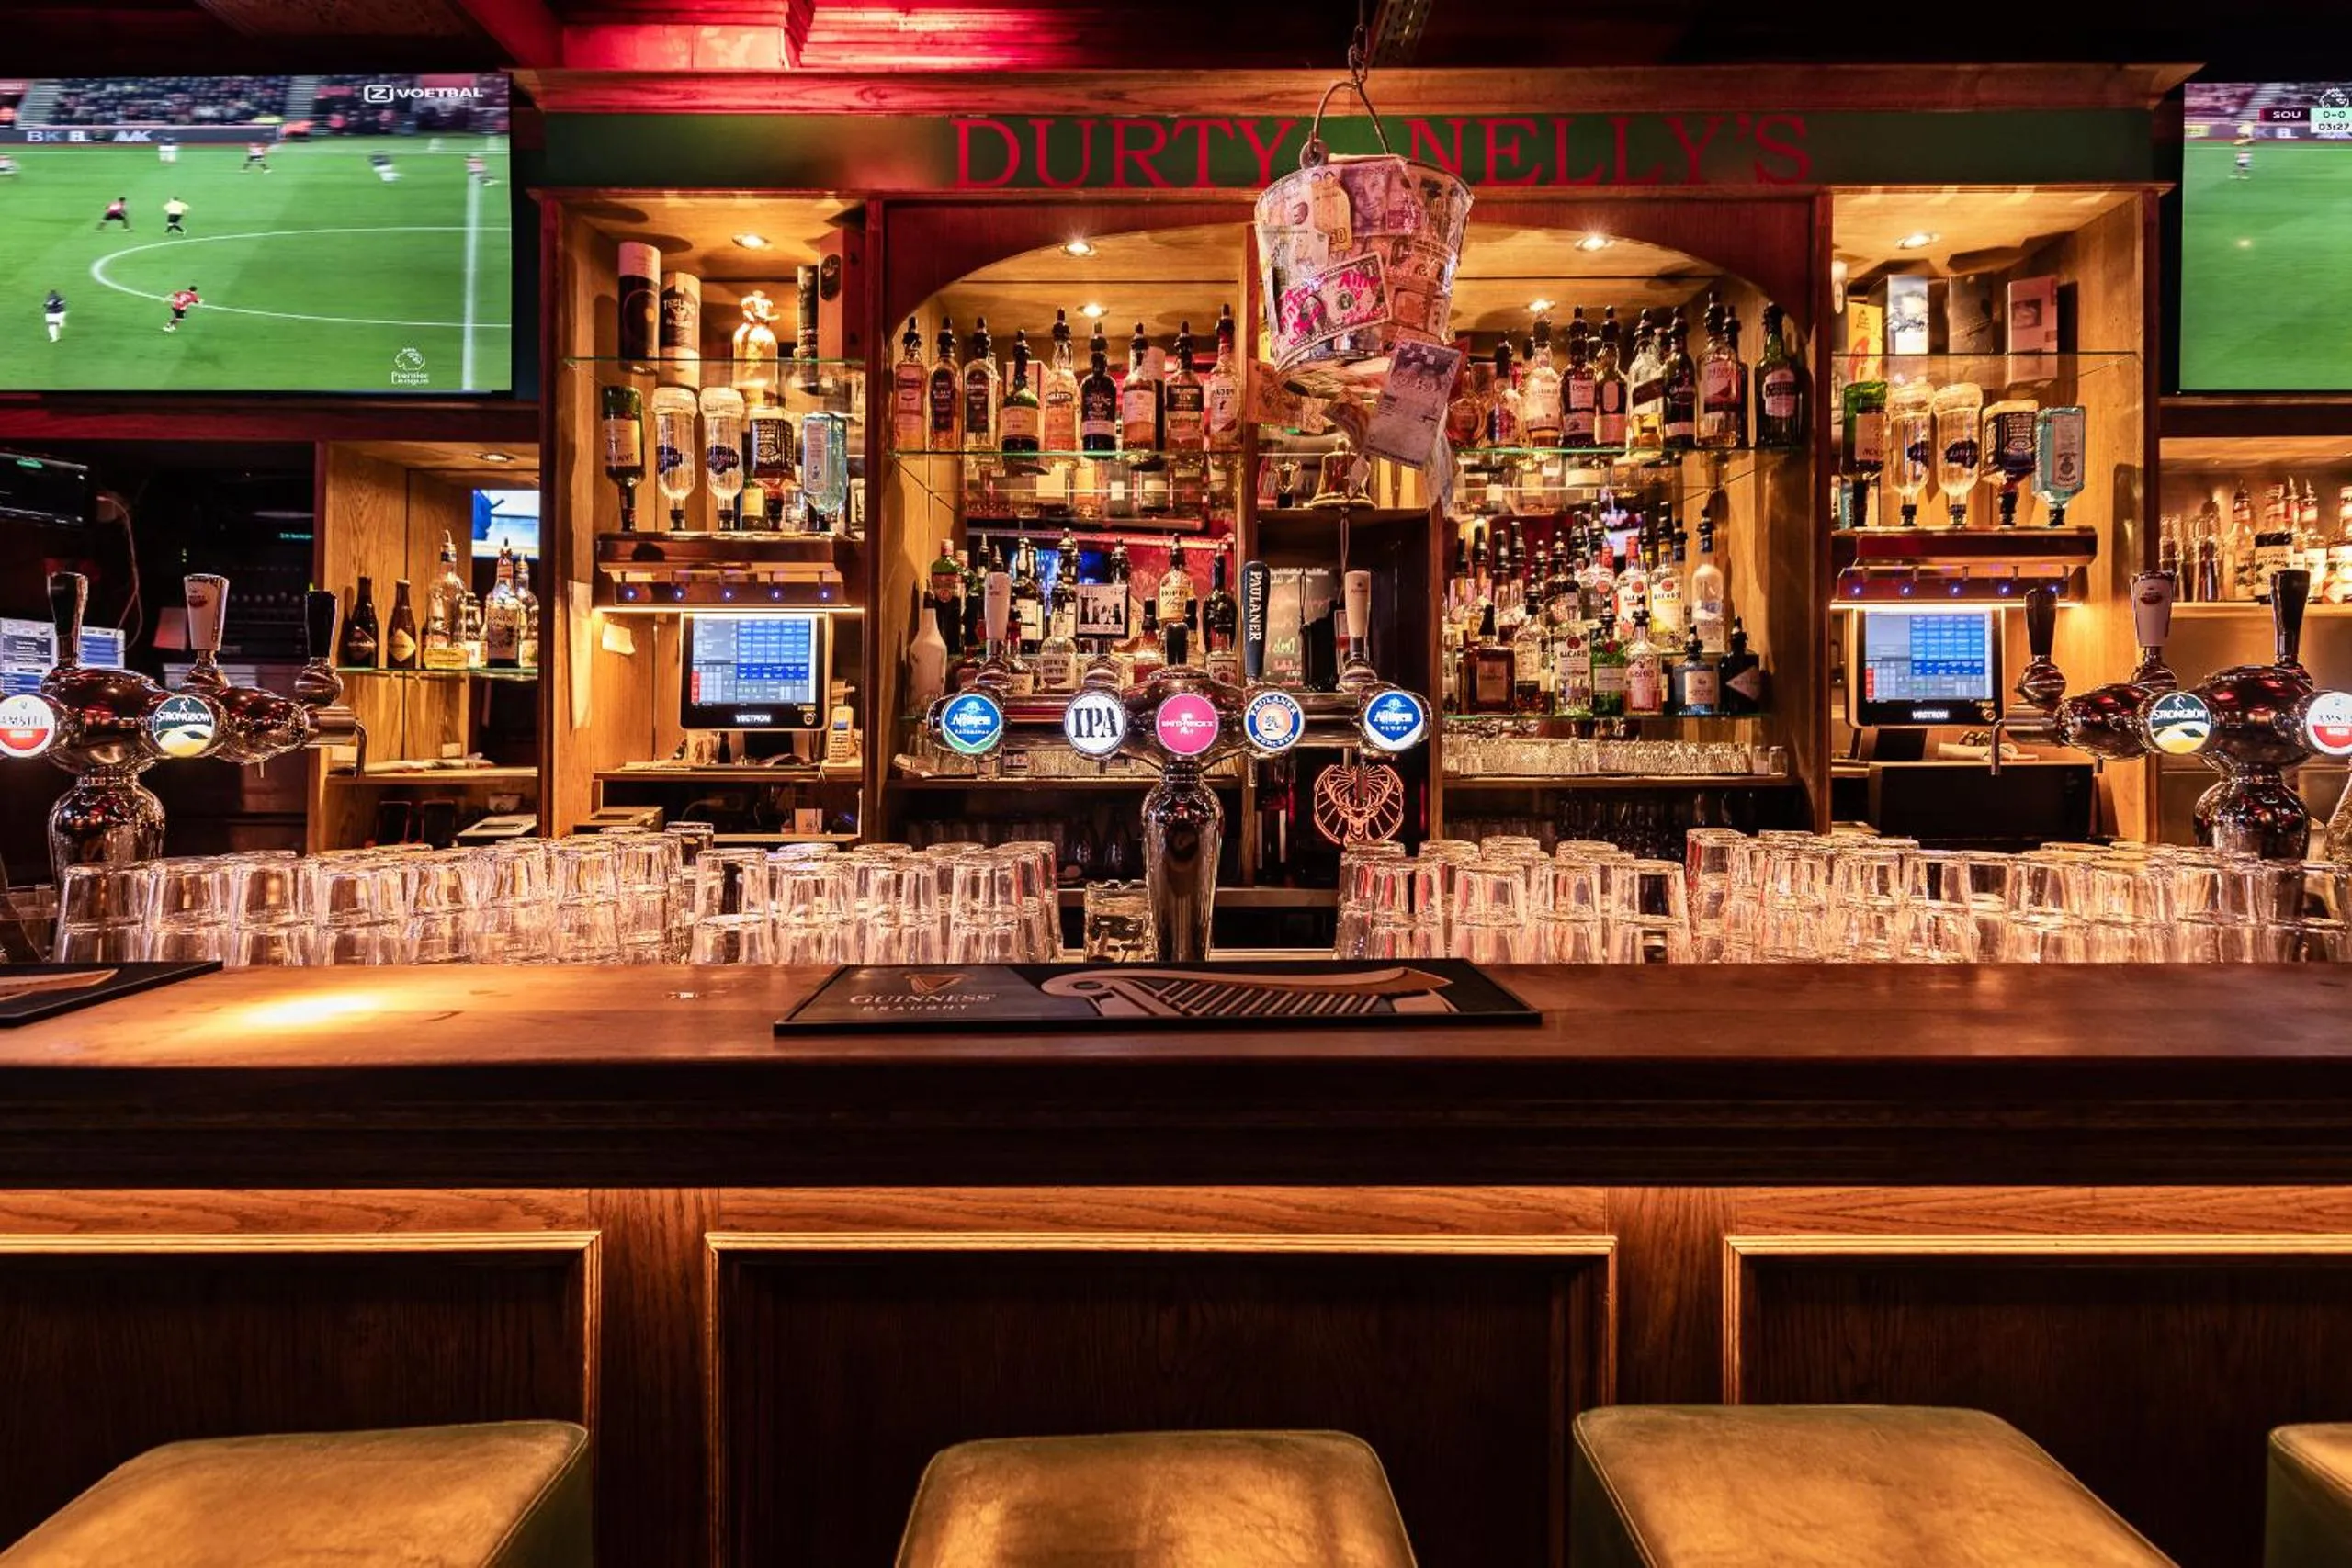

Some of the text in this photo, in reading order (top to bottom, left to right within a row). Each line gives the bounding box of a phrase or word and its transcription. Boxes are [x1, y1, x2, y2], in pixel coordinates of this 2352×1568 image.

[396, 87, 484, 98] VOETBAL
[2272, 110, 2301, 118] SOU
[2318, 123, 2350, 131] 03:27
[950, 112, 1813, 189] DURTY NELLY'S
[1250, 570, 1262, 642] PAULANER
[1250, 694, 1298, 716] PAULANER
[156, 711, 210, 722] STRONGBOW
[2154, 709, 2206, 720] STRONGBOW
[1073, 706, 1119, 739] IPA
[849, 995, 993, 1004] GUINNESS
